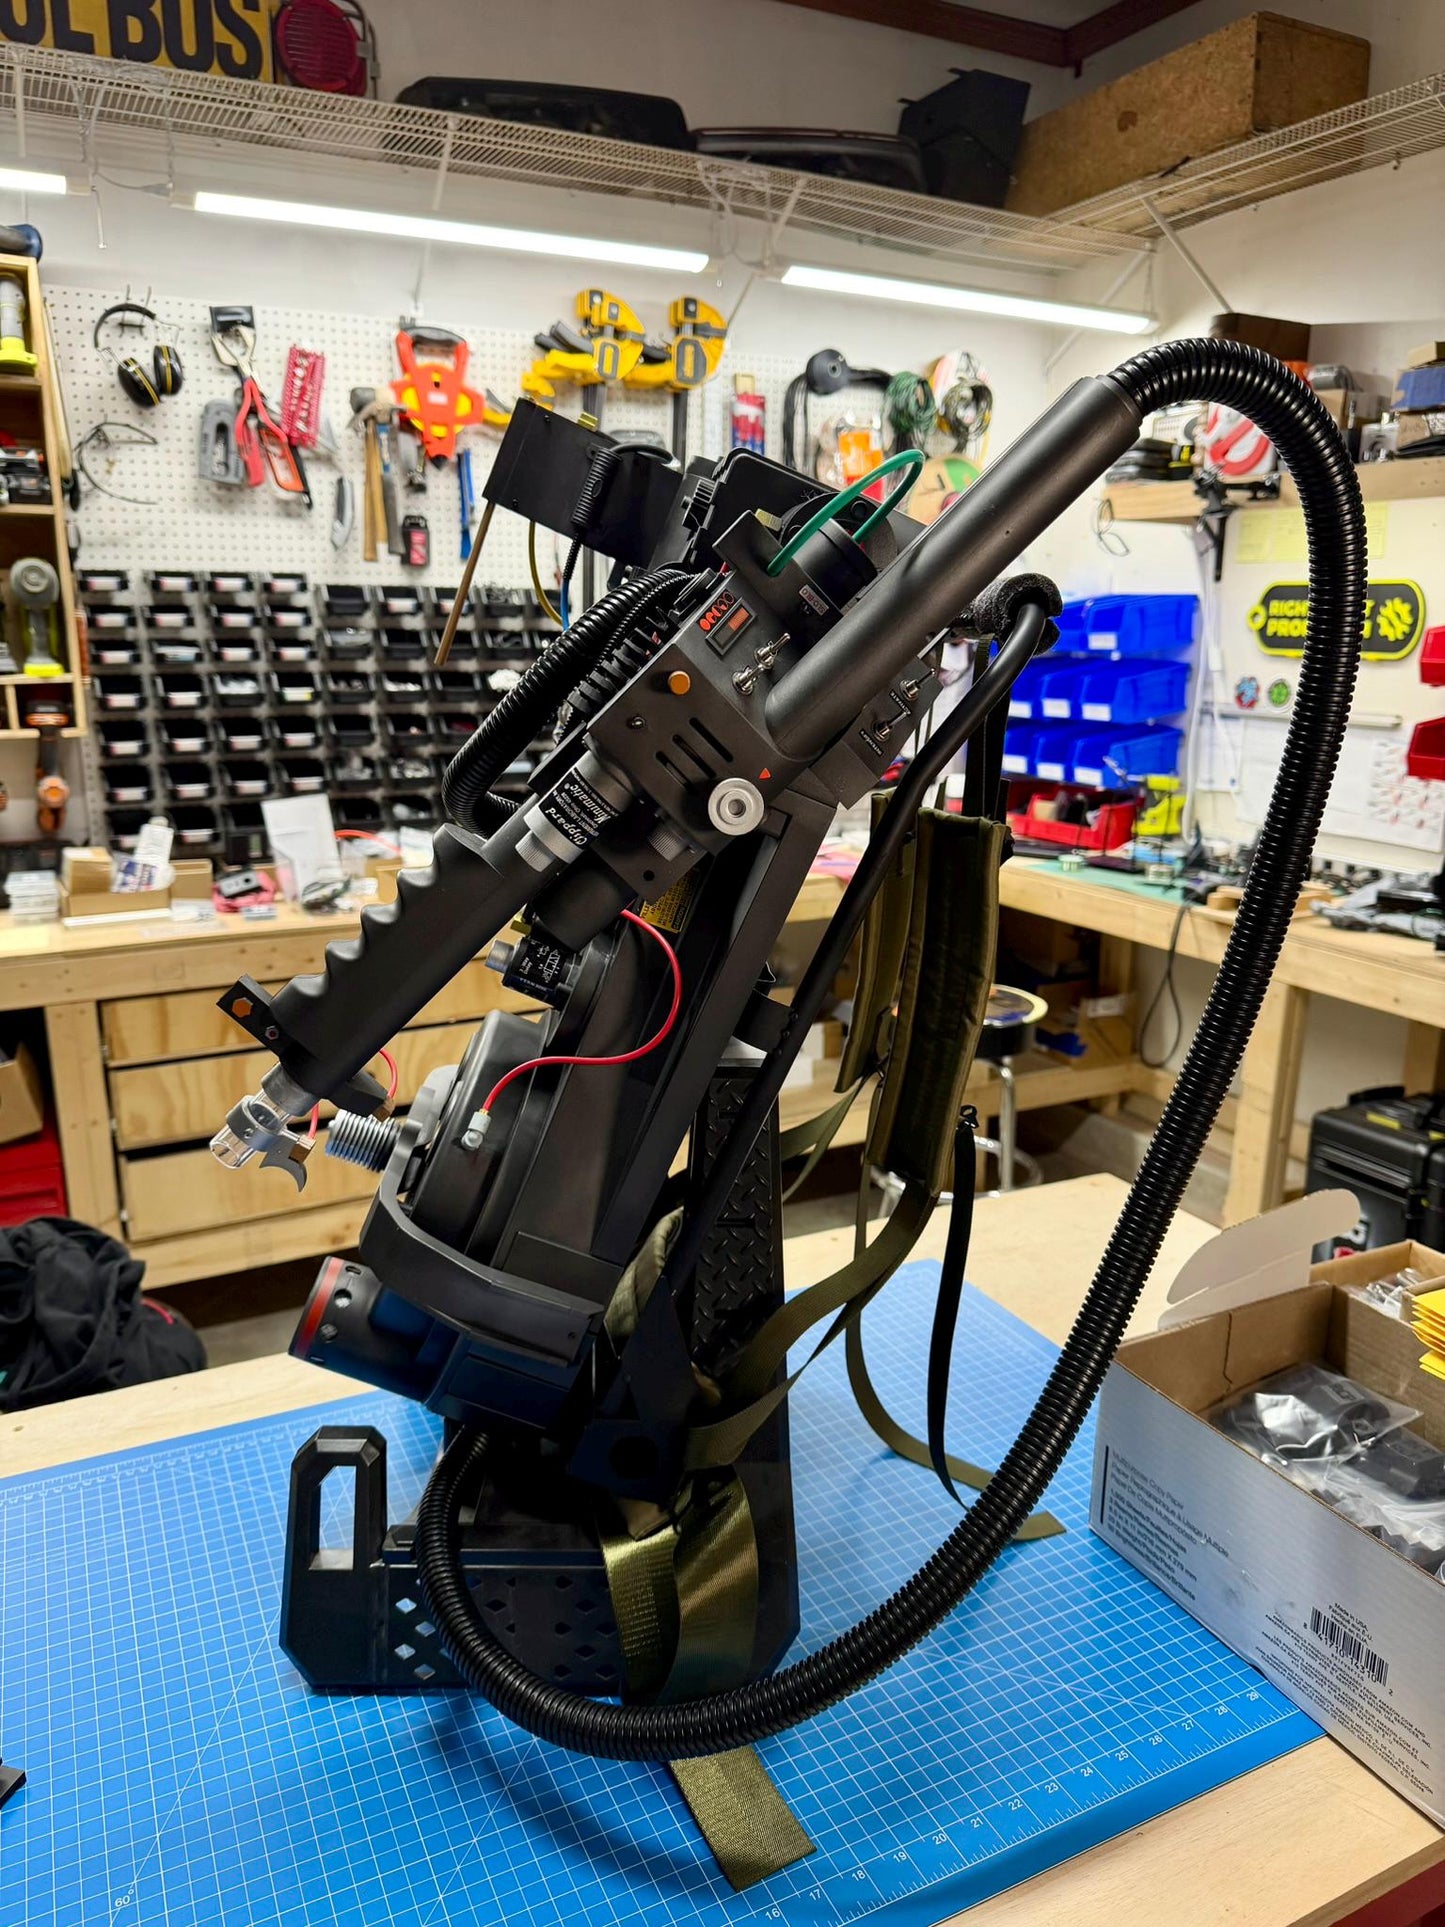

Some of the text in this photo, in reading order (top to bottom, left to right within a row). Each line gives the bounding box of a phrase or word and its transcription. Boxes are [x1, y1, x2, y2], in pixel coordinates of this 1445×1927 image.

[110, 0, 262, 79] BUS
[545, 807, 587, 845] Clippard
[1317, 1633, 1344, 1658] 41710
[1350, 1656, 1376, 1682] 14310
[765, 1691, 1259, 1921] 16 17 18 19 20 21 22 23 24 25 26 27 28 29
